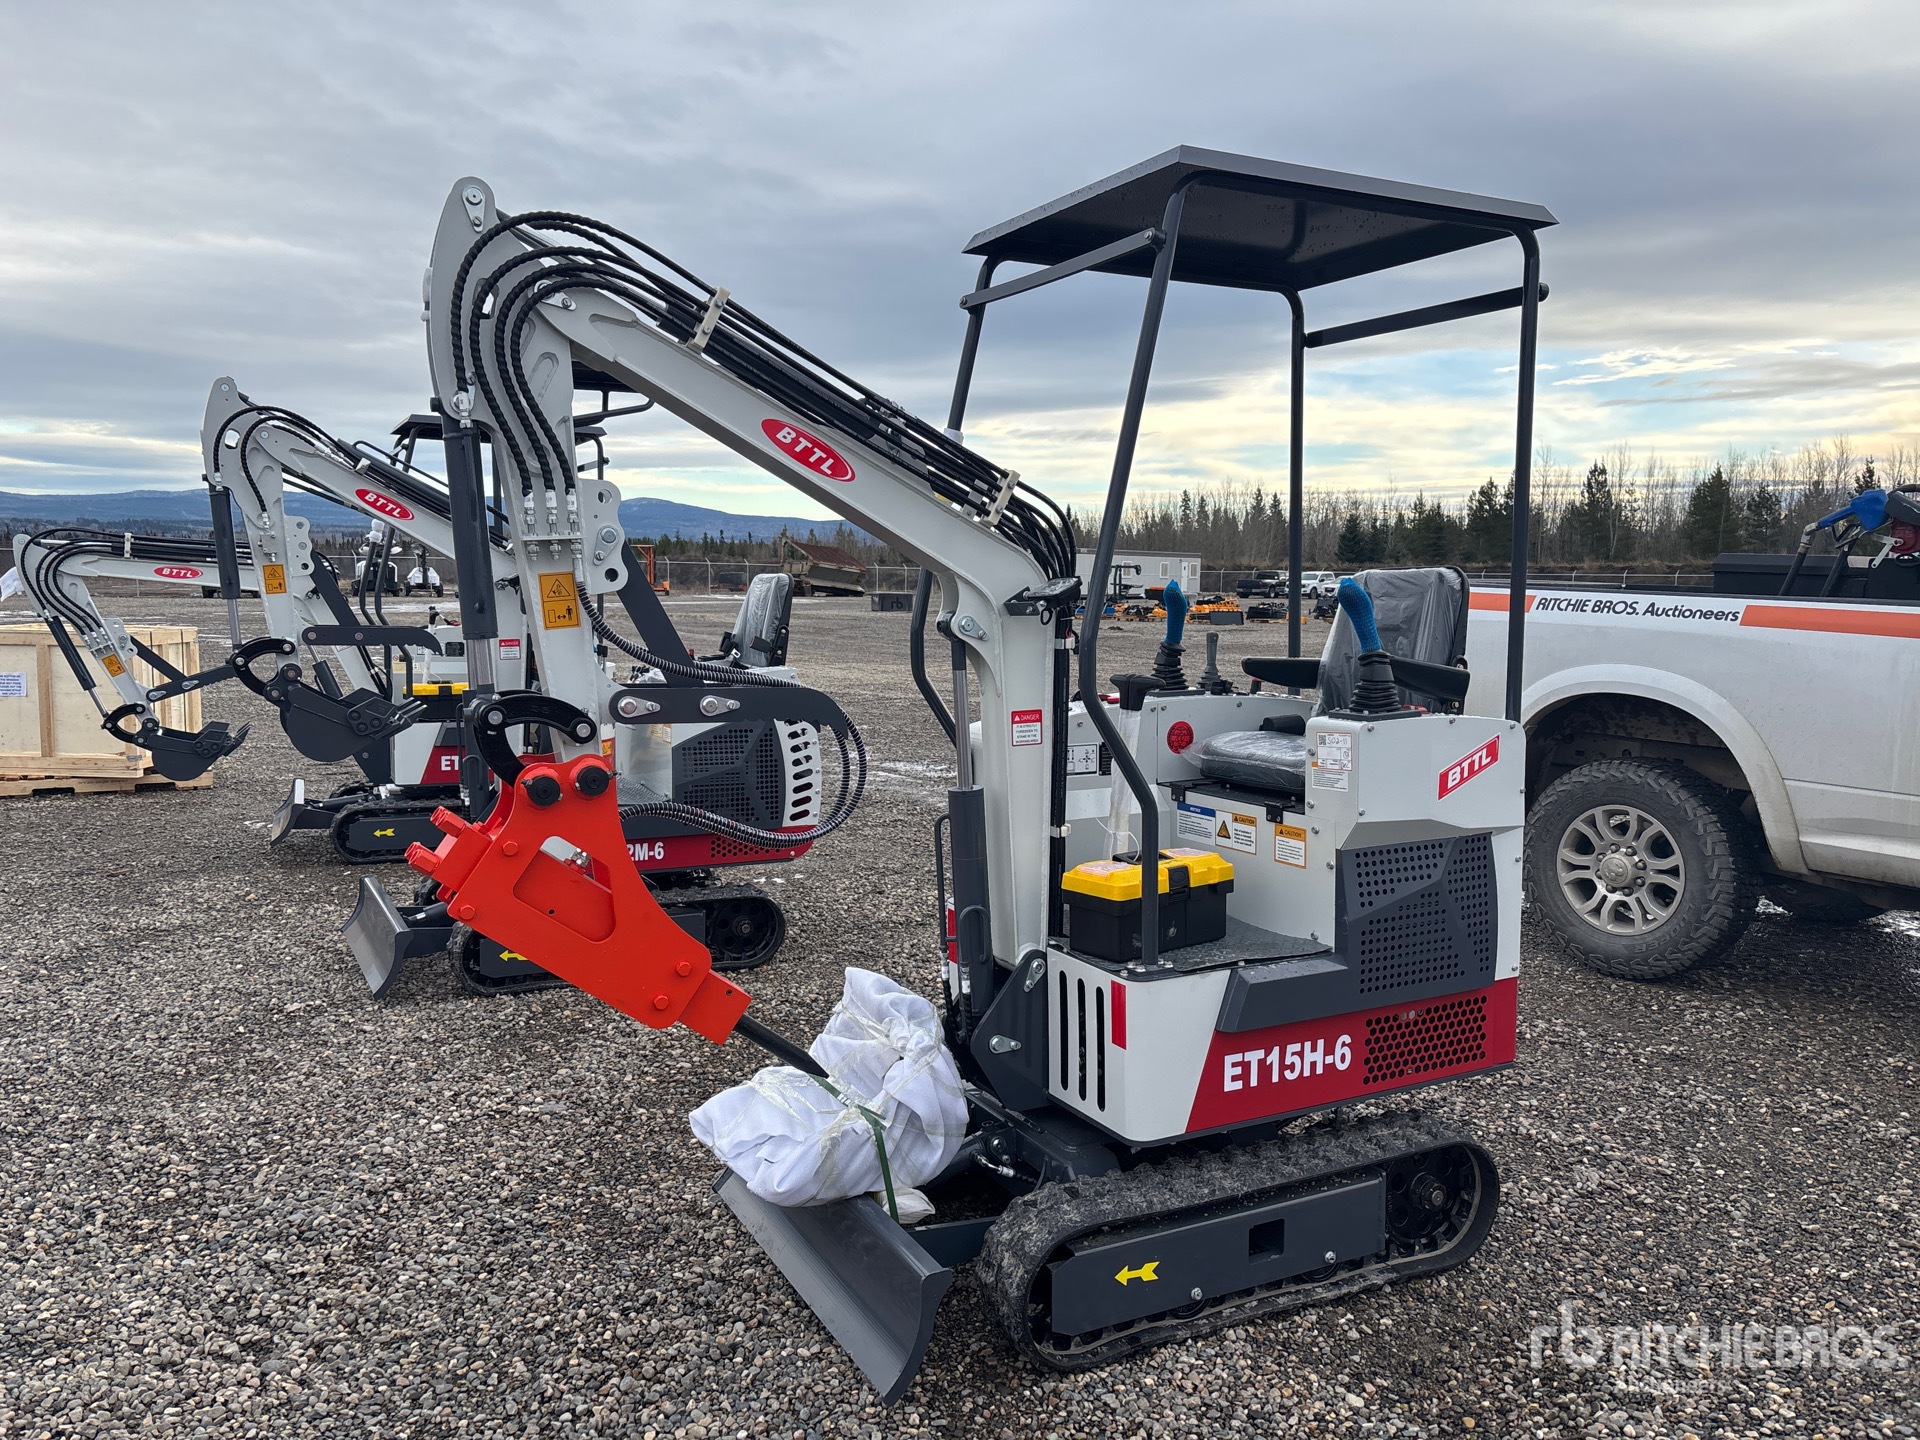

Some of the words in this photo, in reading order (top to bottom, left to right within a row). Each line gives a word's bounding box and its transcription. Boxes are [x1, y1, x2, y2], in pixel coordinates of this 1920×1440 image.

[776, 426, 835, 475] BTTL
[364, 492, 402, 518] BTTL
[161, 567, 193, 578] BTTL
[1535, 597, 1592, 612] RITCHIE
[1590, 600, 1640, 615] BROS.
[1642, 602, 1740, 622] Auctioneers
[1447, 747, 1493, 790] BTTL
[1238, 816, 1255, 825] CAUTION
[1284, 829, 1302, 838] CAUTION
[1223, 1034, 1352, 1092] ET15H-6
